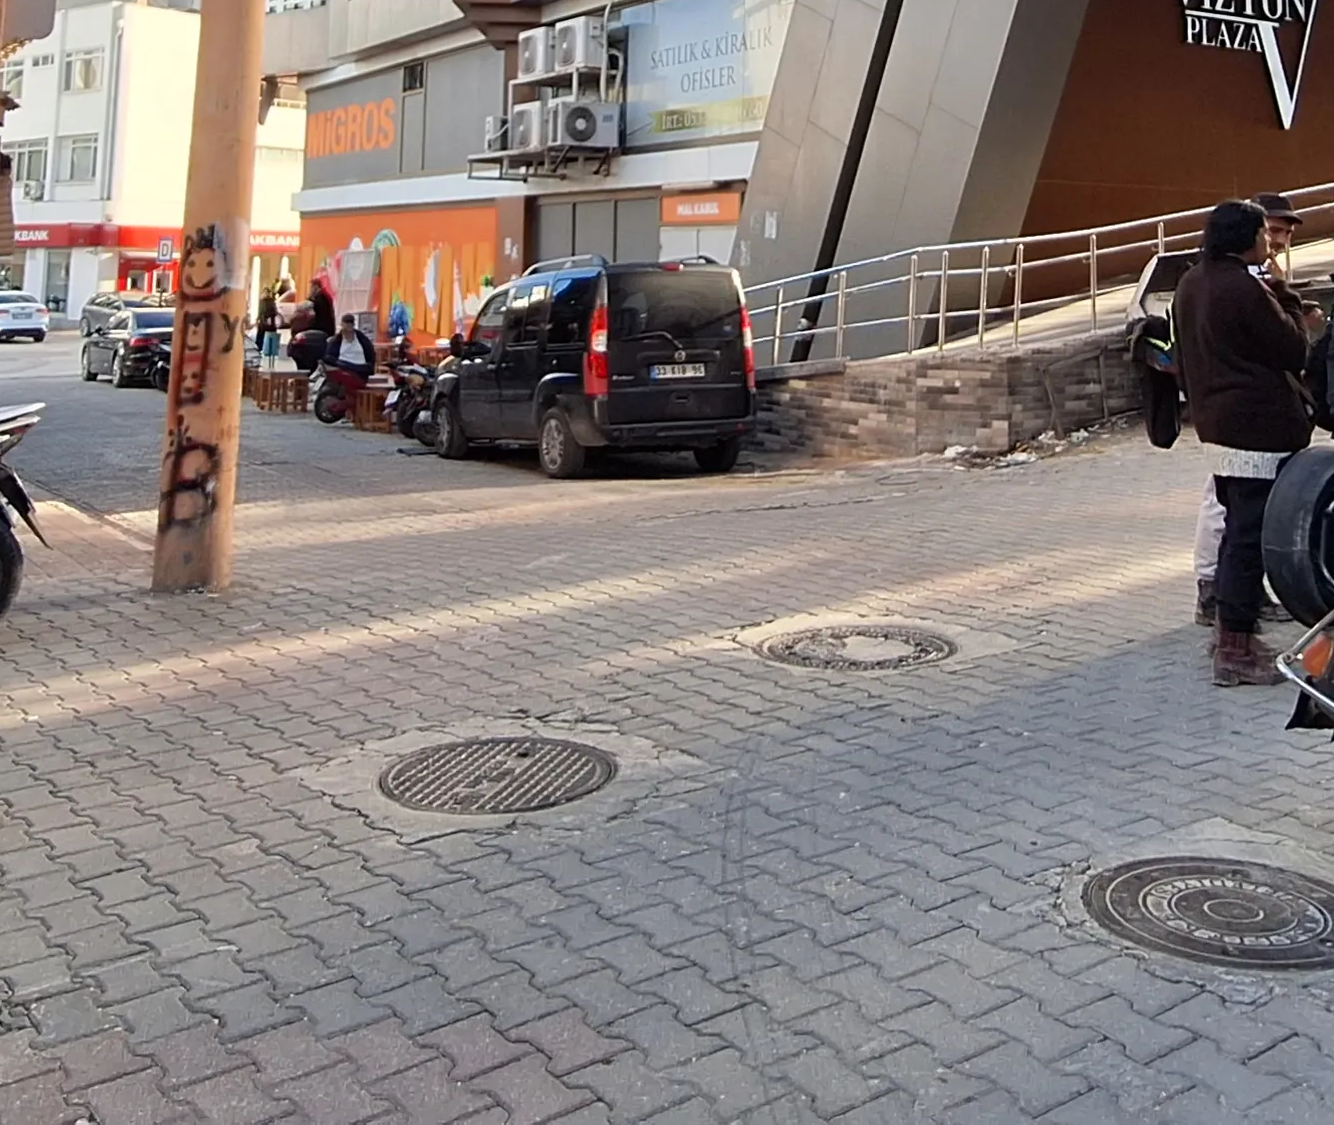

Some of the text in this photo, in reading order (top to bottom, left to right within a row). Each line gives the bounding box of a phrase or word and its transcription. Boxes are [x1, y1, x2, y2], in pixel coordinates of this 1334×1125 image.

[650, 25, 774, 71] SATILIK & KİRALIK
[1185, 16, 1264, 53] PLAZA
[680, 65, 737, 93] OFİSLER
[14, 229, 50, 241] KBANK
